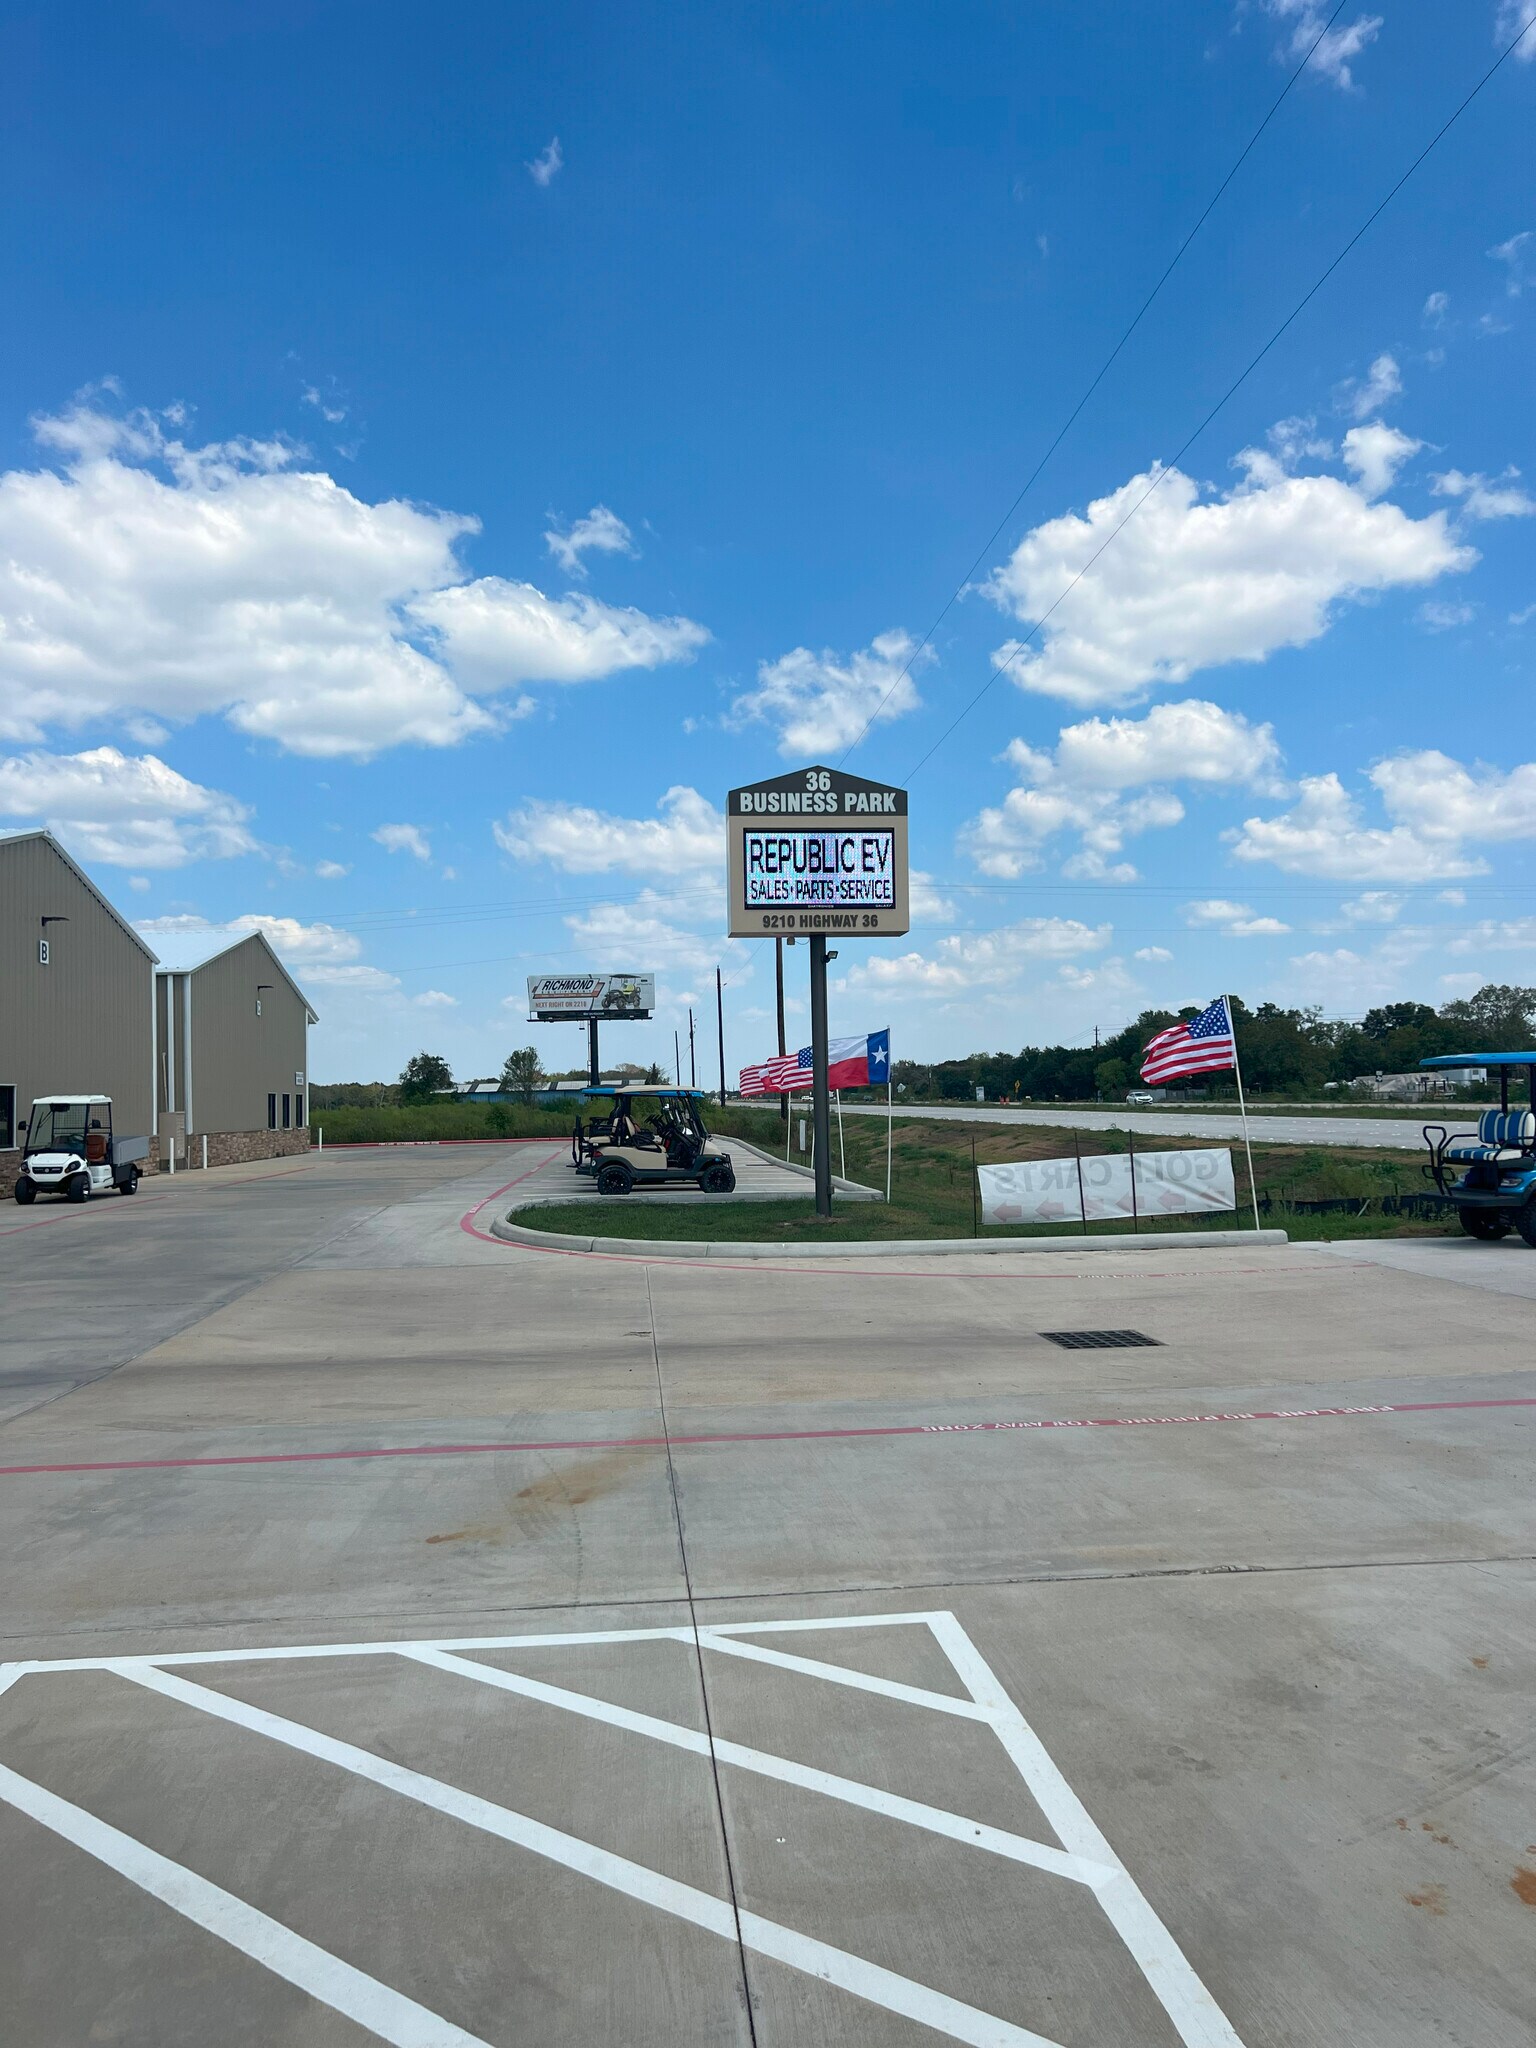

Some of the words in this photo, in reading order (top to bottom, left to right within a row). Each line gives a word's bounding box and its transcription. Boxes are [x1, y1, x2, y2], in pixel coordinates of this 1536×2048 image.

[806, 771, 831, 791] 36
[740, 793, 838, 813] BUSINESS
[844, 793, 896, 812] PARK
[750, 838, 855, 873] REPUBLIC
[862, 838, 890, 873] EV
[763, 915, 795, 928] 9210
[799, 914, 858, 928] HIGHWAY
[862, 914, 878, 927] 36
[42, 943, 47, 961] B
[542, 979, 594, 991] RICHMOND
[1272, 1408, 1338, 1417] LANE
[1338, 1405, 1395, 1414] FIRE
[1117, 1414, 1219, 1423] PARKING
[920, 1423, 985, 1432] ZONE
[994, 1421, 1042, 1429] AWAY
